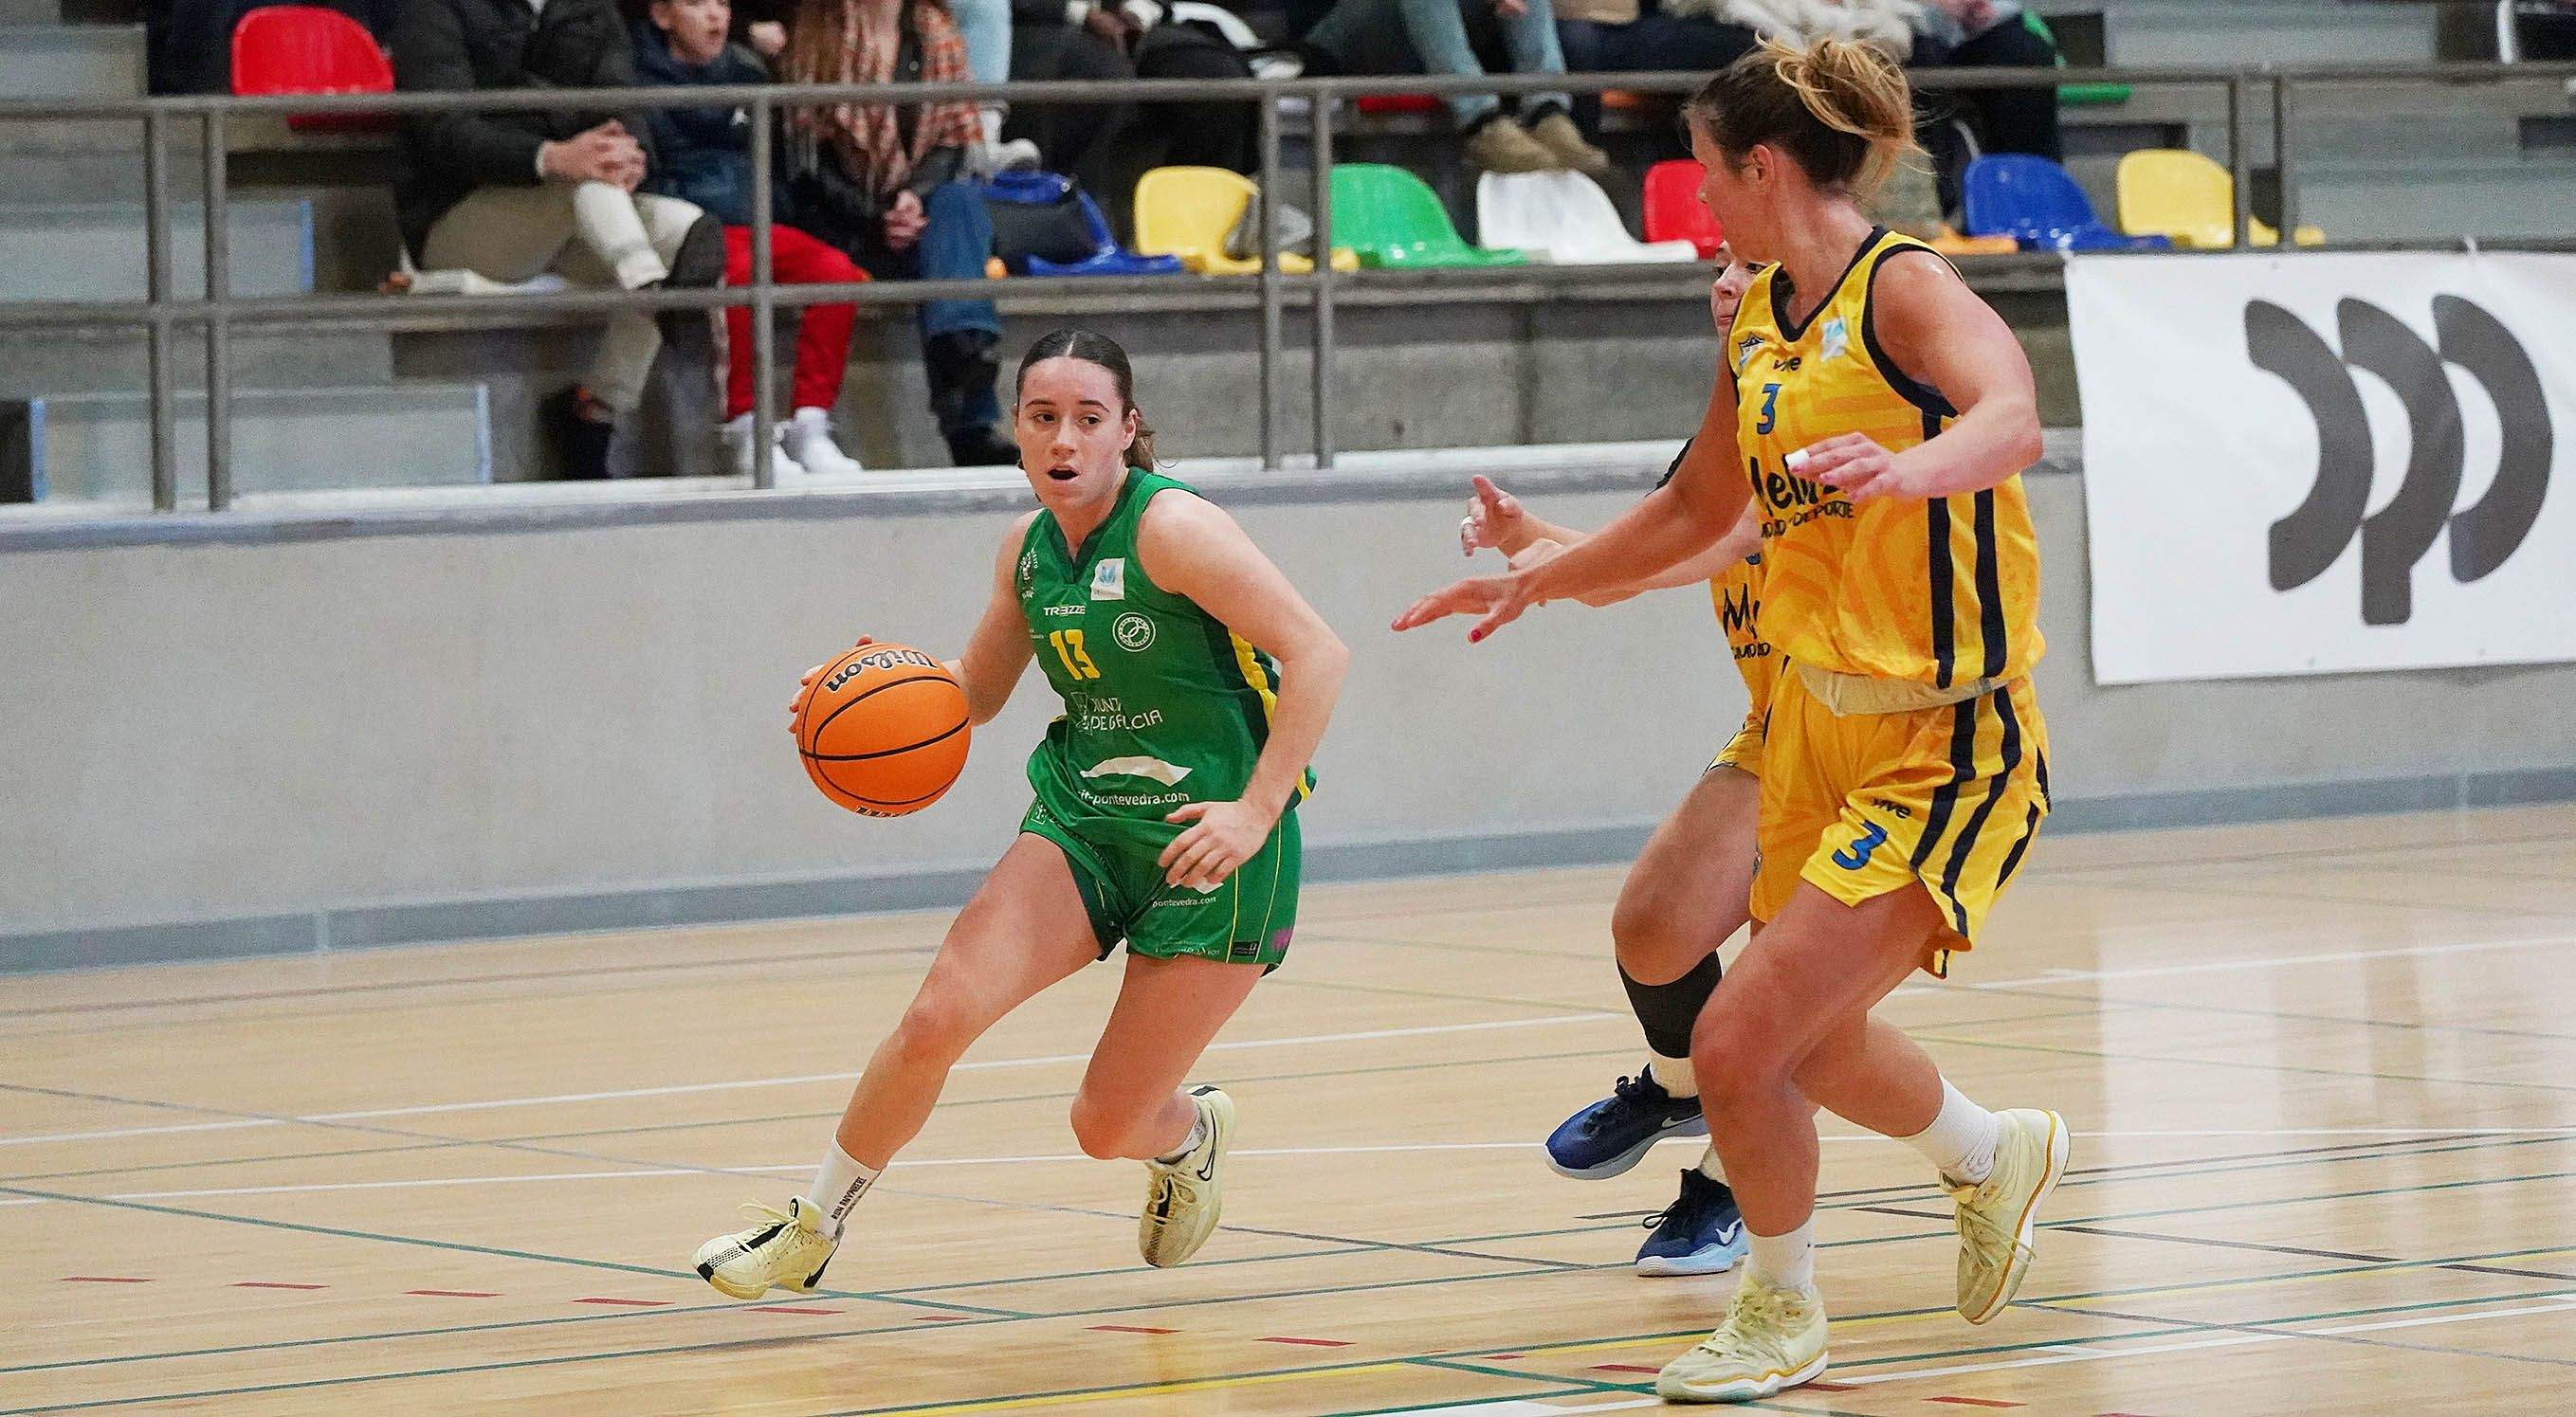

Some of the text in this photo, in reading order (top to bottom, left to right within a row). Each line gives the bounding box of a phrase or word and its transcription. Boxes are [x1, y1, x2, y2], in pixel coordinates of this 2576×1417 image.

[1756, 383, 1782, 435] 3
[825, 649, 937, 692] Wilson
[1050, 629, 1101, 681] 13
[1091, 709, 1163, 731] DE GALCIA
[1078, 789, 1190, 806] it-pontevedra.com
[1831, 819, 1888, 870] 3
